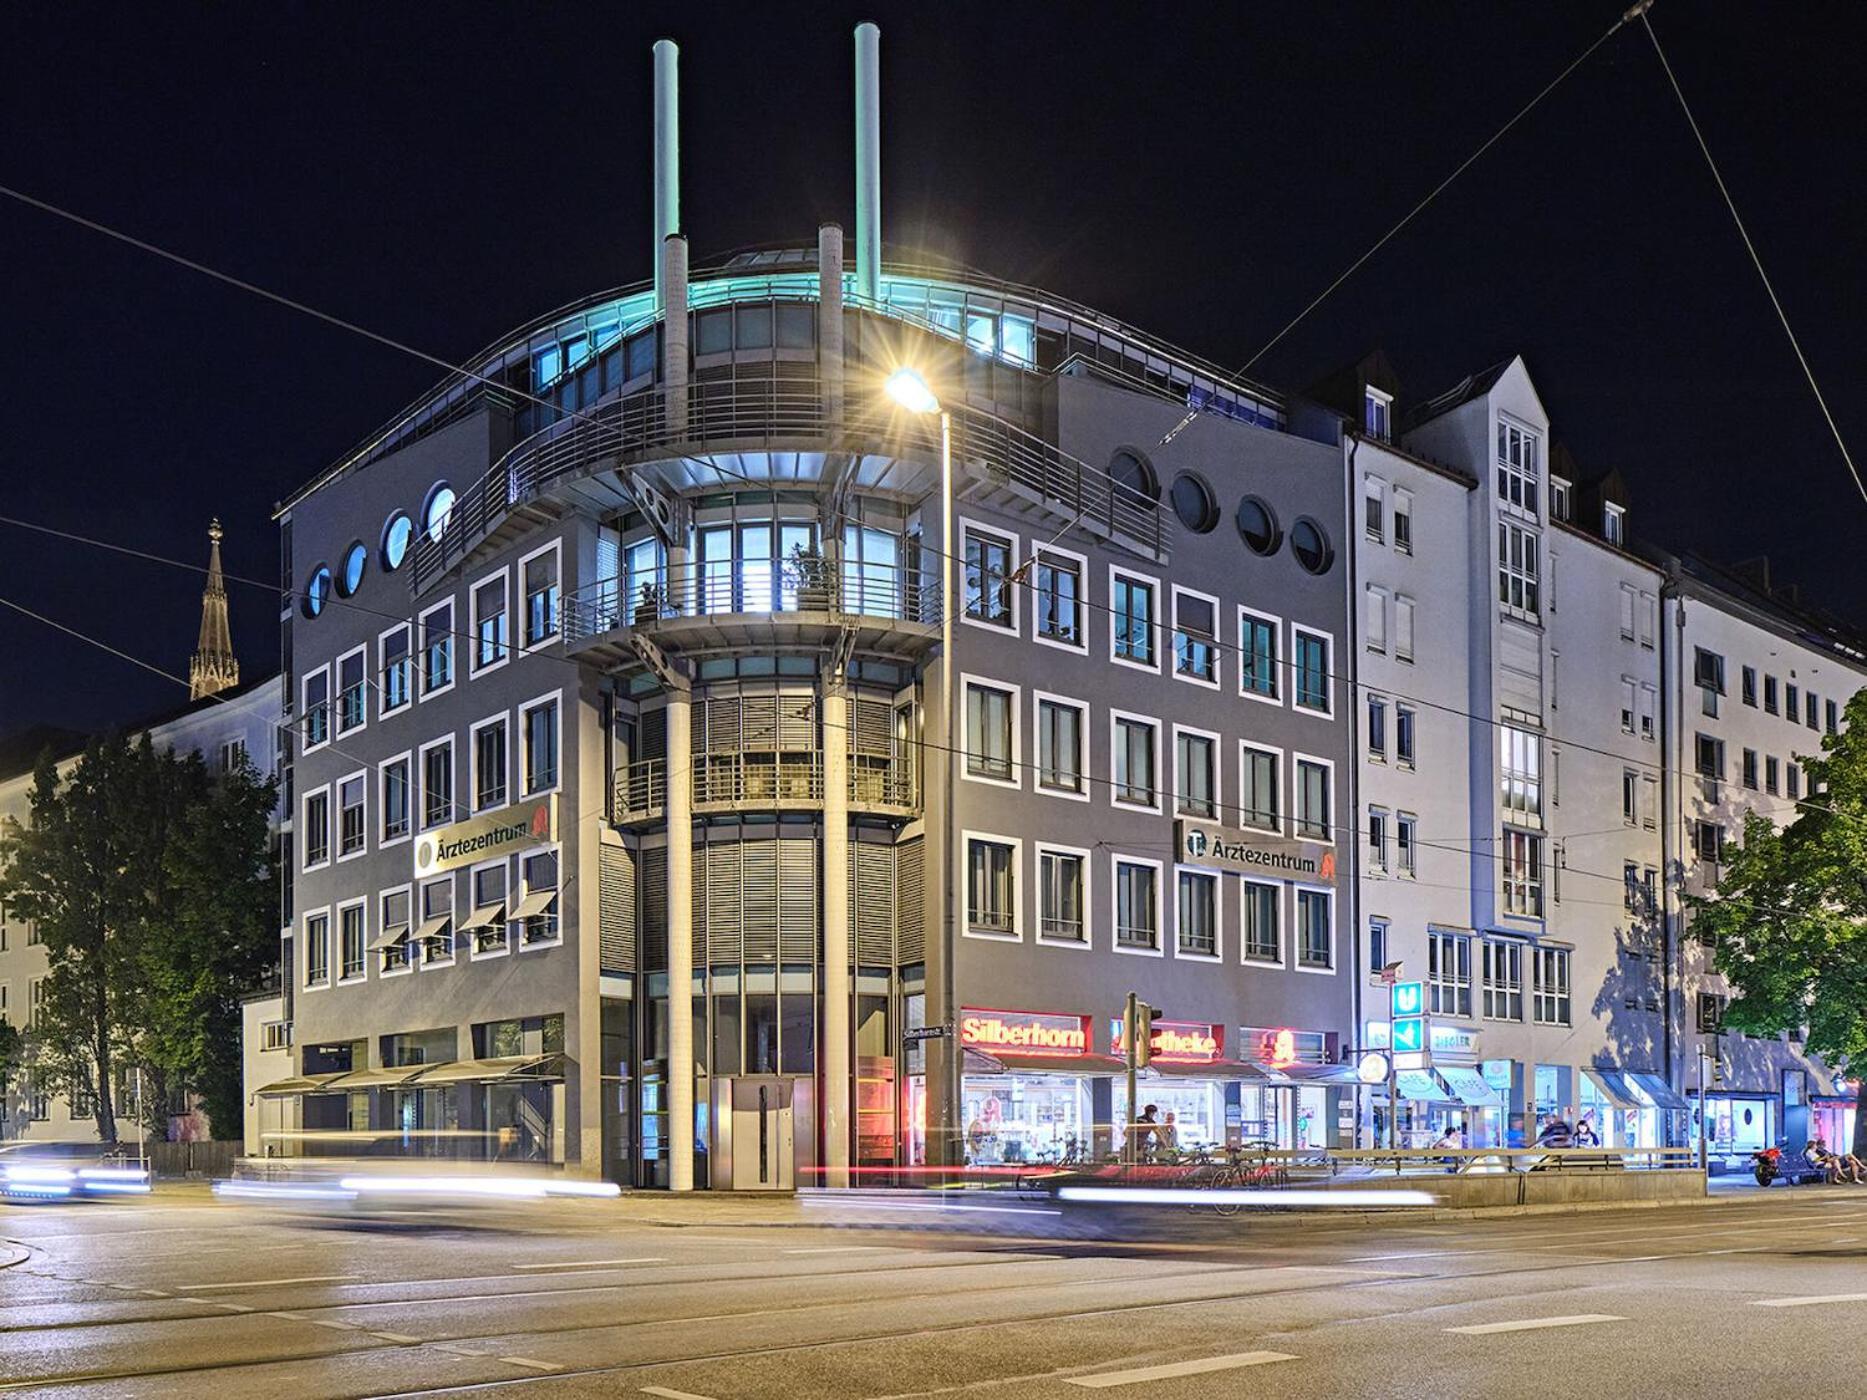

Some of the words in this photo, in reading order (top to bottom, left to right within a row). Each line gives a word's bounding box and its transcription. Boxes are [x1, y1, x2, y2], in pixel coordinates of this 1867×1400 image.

[436, 821, 527, 862] Ärztezentrum
[1212, 835, 1315, 873] Ärztezentrum
[963, 1018, 1085, 1048] Silberhorn
